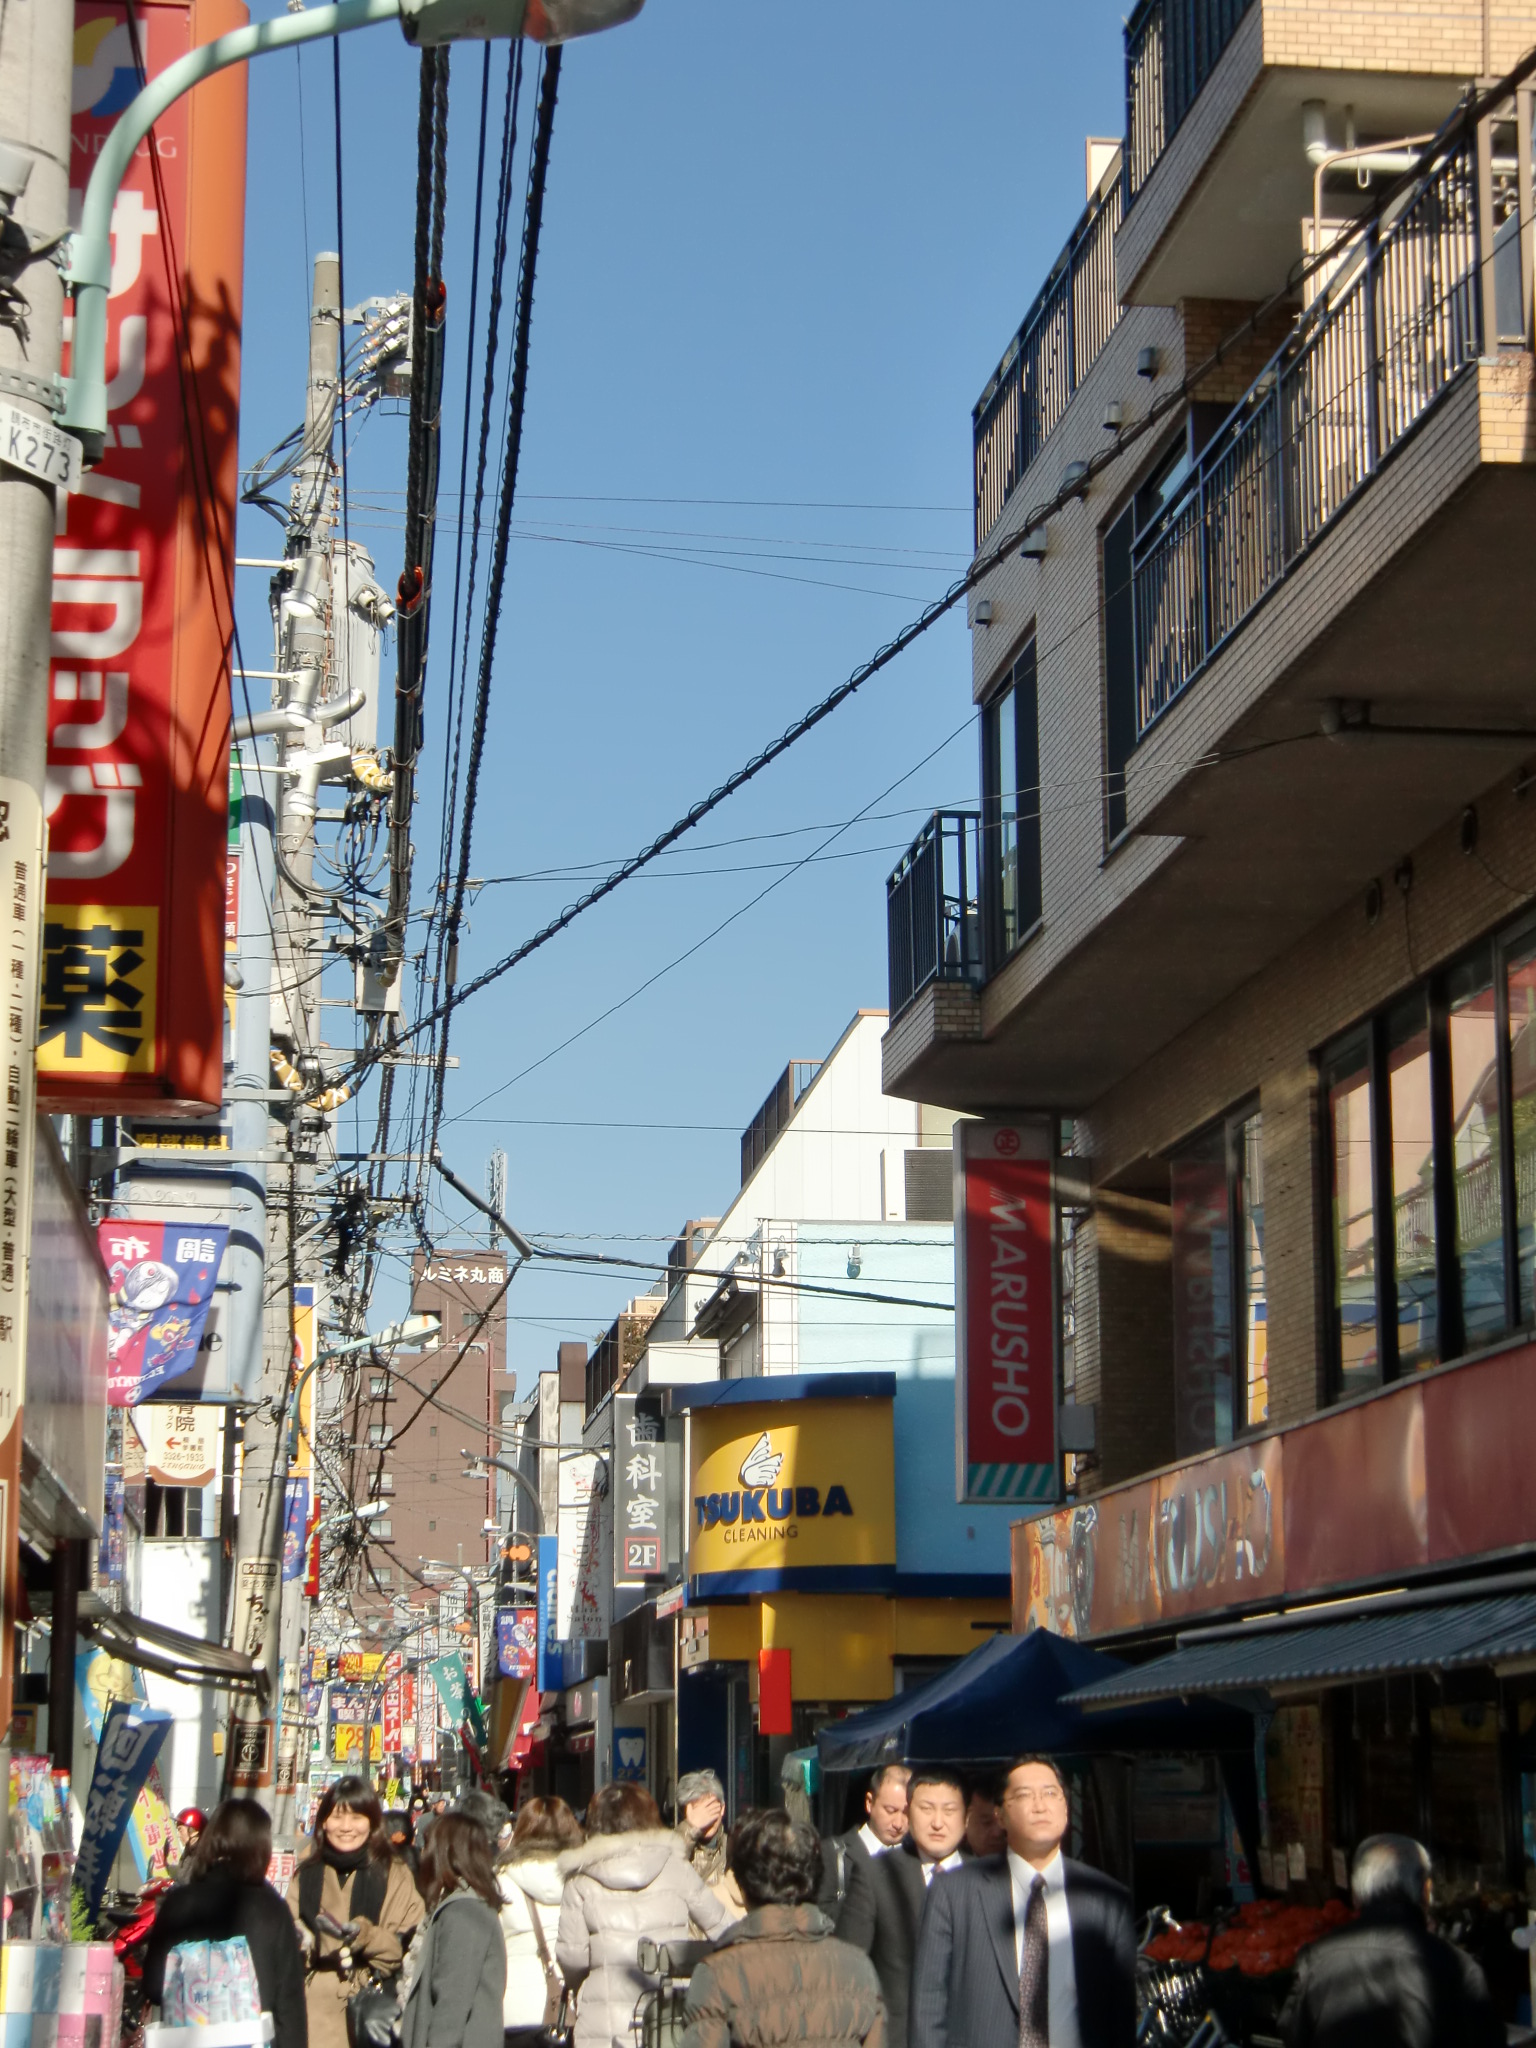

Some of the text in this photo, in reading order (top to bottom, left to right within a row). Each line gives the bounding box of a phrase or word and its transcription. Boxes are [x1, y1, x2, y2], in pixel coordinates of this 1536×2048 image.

[9, 426, 71, 482] K273
[42, 922, 145, 1060] 薬
[989, 1186, 1030, 1436] MARUSHO
[625, 1412, 662, 1530] 歯科室
[694, 1485, 853, 1527] TSUKUBA
[628, 1544, 656, 1567] 2F
[724, 1525, 799, 1544] CLEANING
